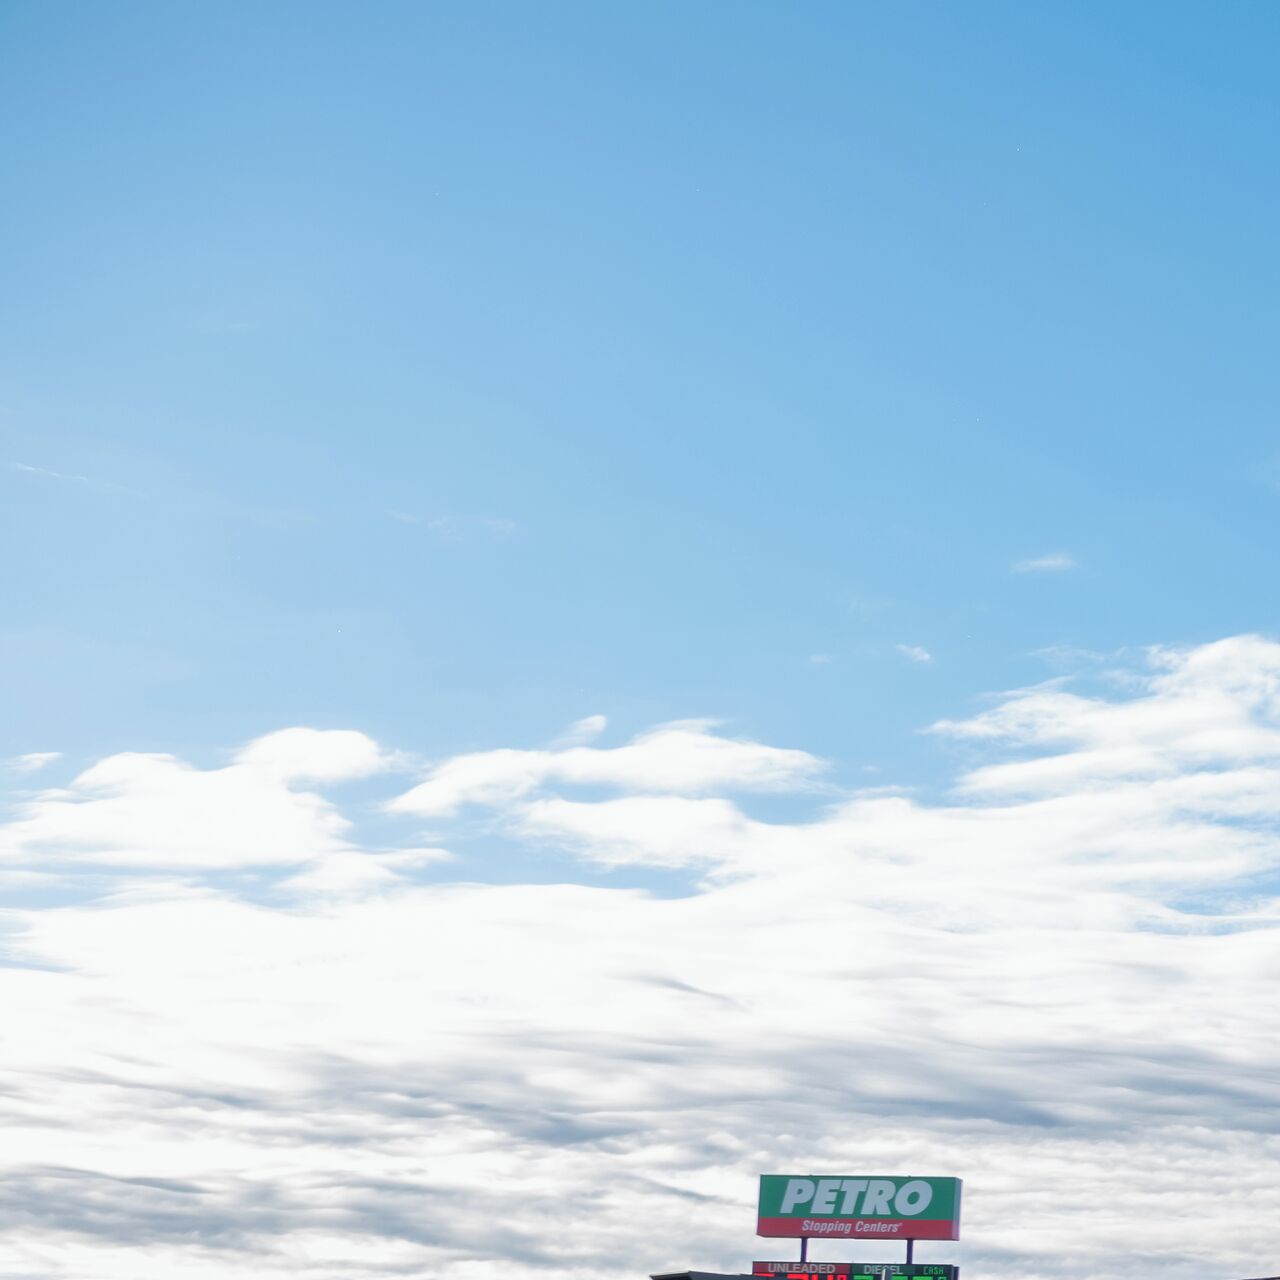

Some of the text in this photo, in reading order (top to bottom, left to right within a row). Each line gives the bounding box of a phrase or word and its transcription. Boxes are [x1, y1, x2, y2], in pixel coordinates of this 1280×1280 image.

[780, 1178, 933, 1216] PETRO
[802, 1219, 900, 1233] Stopping Centers
[768, 1263, 836, 1275] UNLEADED
[923, 1266, 944, 1275] CASH
